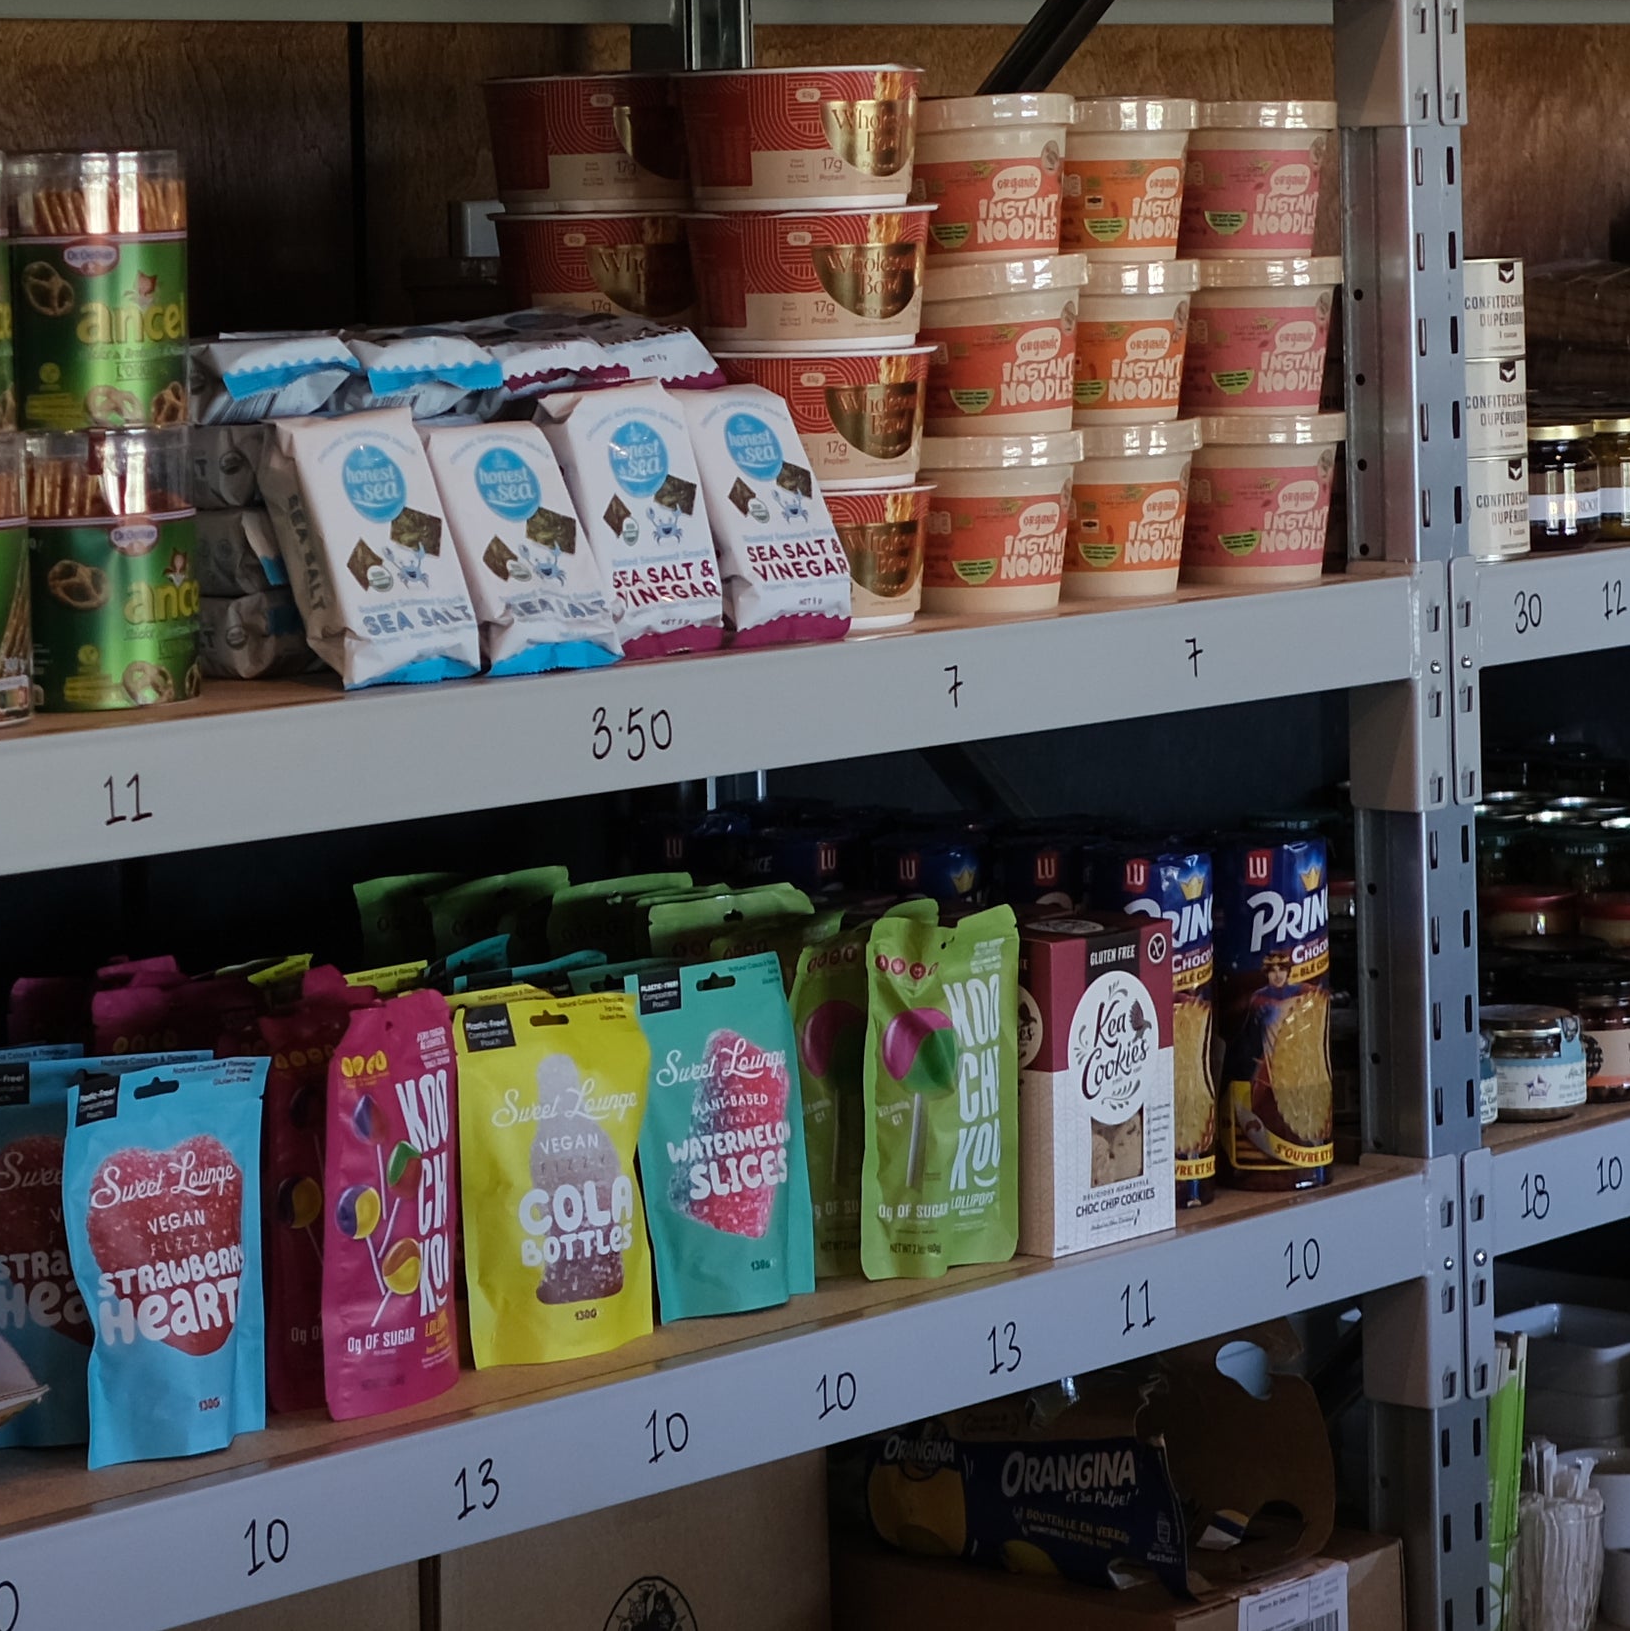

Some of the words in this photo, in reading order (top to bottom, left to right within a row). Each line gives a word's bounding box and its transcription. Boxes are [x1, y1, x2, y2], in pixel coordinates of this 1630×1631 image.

[979, 194, 1059, 218] INSTANT
[977, 218, 1057, 244] NOODLES
[826, 441, 847, 457] 17g
[346, 466, 395, 483] honest
[363, 482, 399, 500] sea
[746, 543, 781, 563] SEA
[785, 539, 826, 559] SALT
[831, 538, 842, 554] &
[752, 557, 849, 581] VINEGAR
[362, 608, 415, 636] SEA
[418, 604, 471, 628] SALT
[1514, 592, 1542, 635] 30
[1602, 581, 1628, 620] 12
[1186, 640, 1204, 678] 7
[945, 666, 963, 707] 7
[104, 773, 152, 826] 11
[1249, 856, 1267, 879] LU
[1090, 948, 1116, 967] GLUTEN
[1118, 945, 1135, 960] FREE
[1093, 1000, 1127, 1048] Kea
[1081, 1038, 1149, 1100] Cookies
[491, 1088, 557, 1127] Sweet
[569, 1078, 637, 1122] Lounge
[90, 1166, 166, 1209] Sweet
[168, 1150, 236, 1196] Lounge
[689, 1150, 787, 1201] SLICES
[1596, 1155, 1623, 1195] 10
[519, 1175, 633, 1236] COLA
[1076, 1203, 1099, 1217] CHOC
[1101, 1197, 1119, 1212] CHIP
[1120, 1188, 1155, 1207] COOKIES
[1520, 1174, 1550, 1220] 18
[147, 1209, 206, 1235] VEGAN
[1283, 1237, 1321, 1289] 10
[1120, 1279, 1156, 1334] 11
[986, 1322, 1022, 1375] 13
[816, 1372, 857, 1420] 10
[644, 1410, 690, 1465] 10
[453, 1457, 500, 1510] 13
[1001, 1450, 1136, 1498] ORANGINA
[243, 1518, 289, 1576] 10
